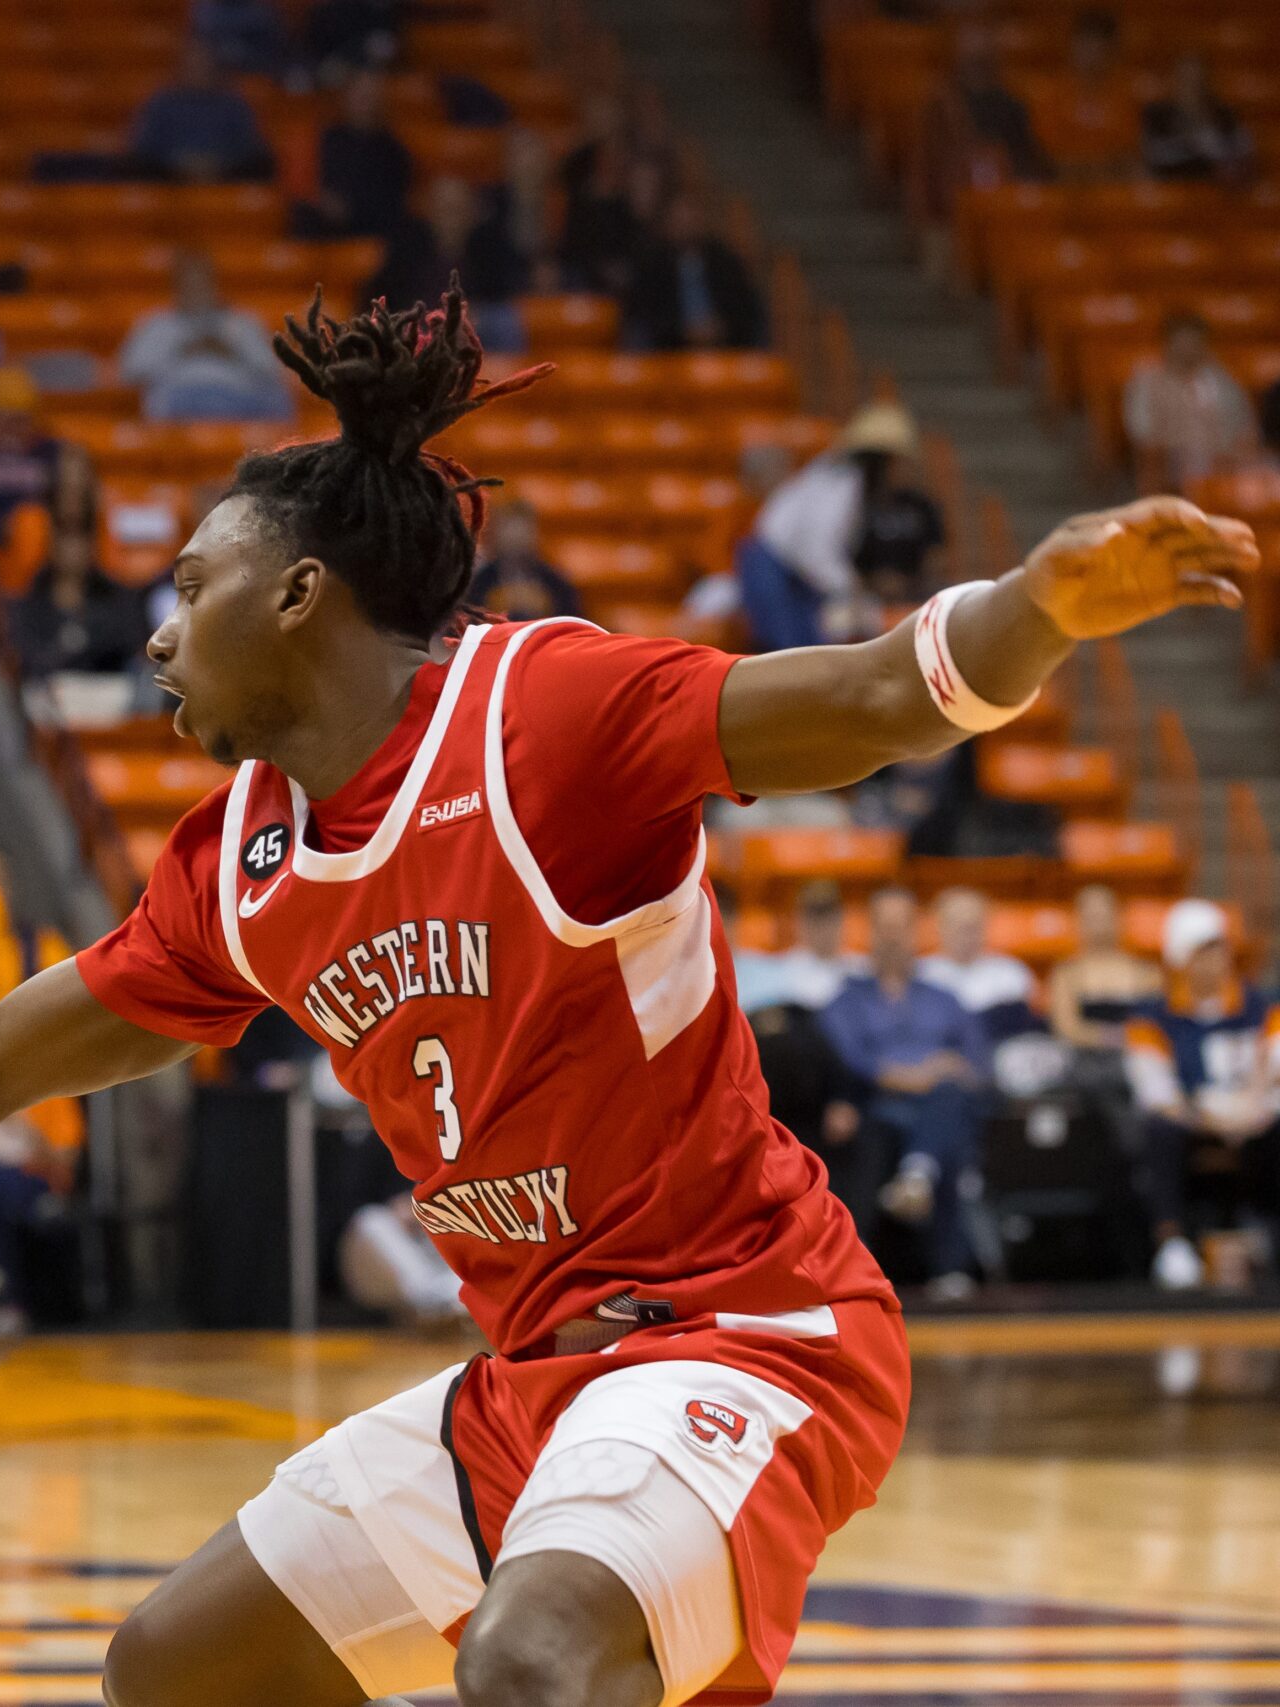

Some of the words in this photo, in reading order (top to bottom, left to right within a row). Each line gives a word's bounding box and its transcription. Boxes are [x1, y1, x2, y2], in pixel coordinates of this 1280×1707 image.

[246, 827, 284, 870] 45
[303, 918, 492, 1050] WESTERN
[412, 1034, 463, 1163] 3
